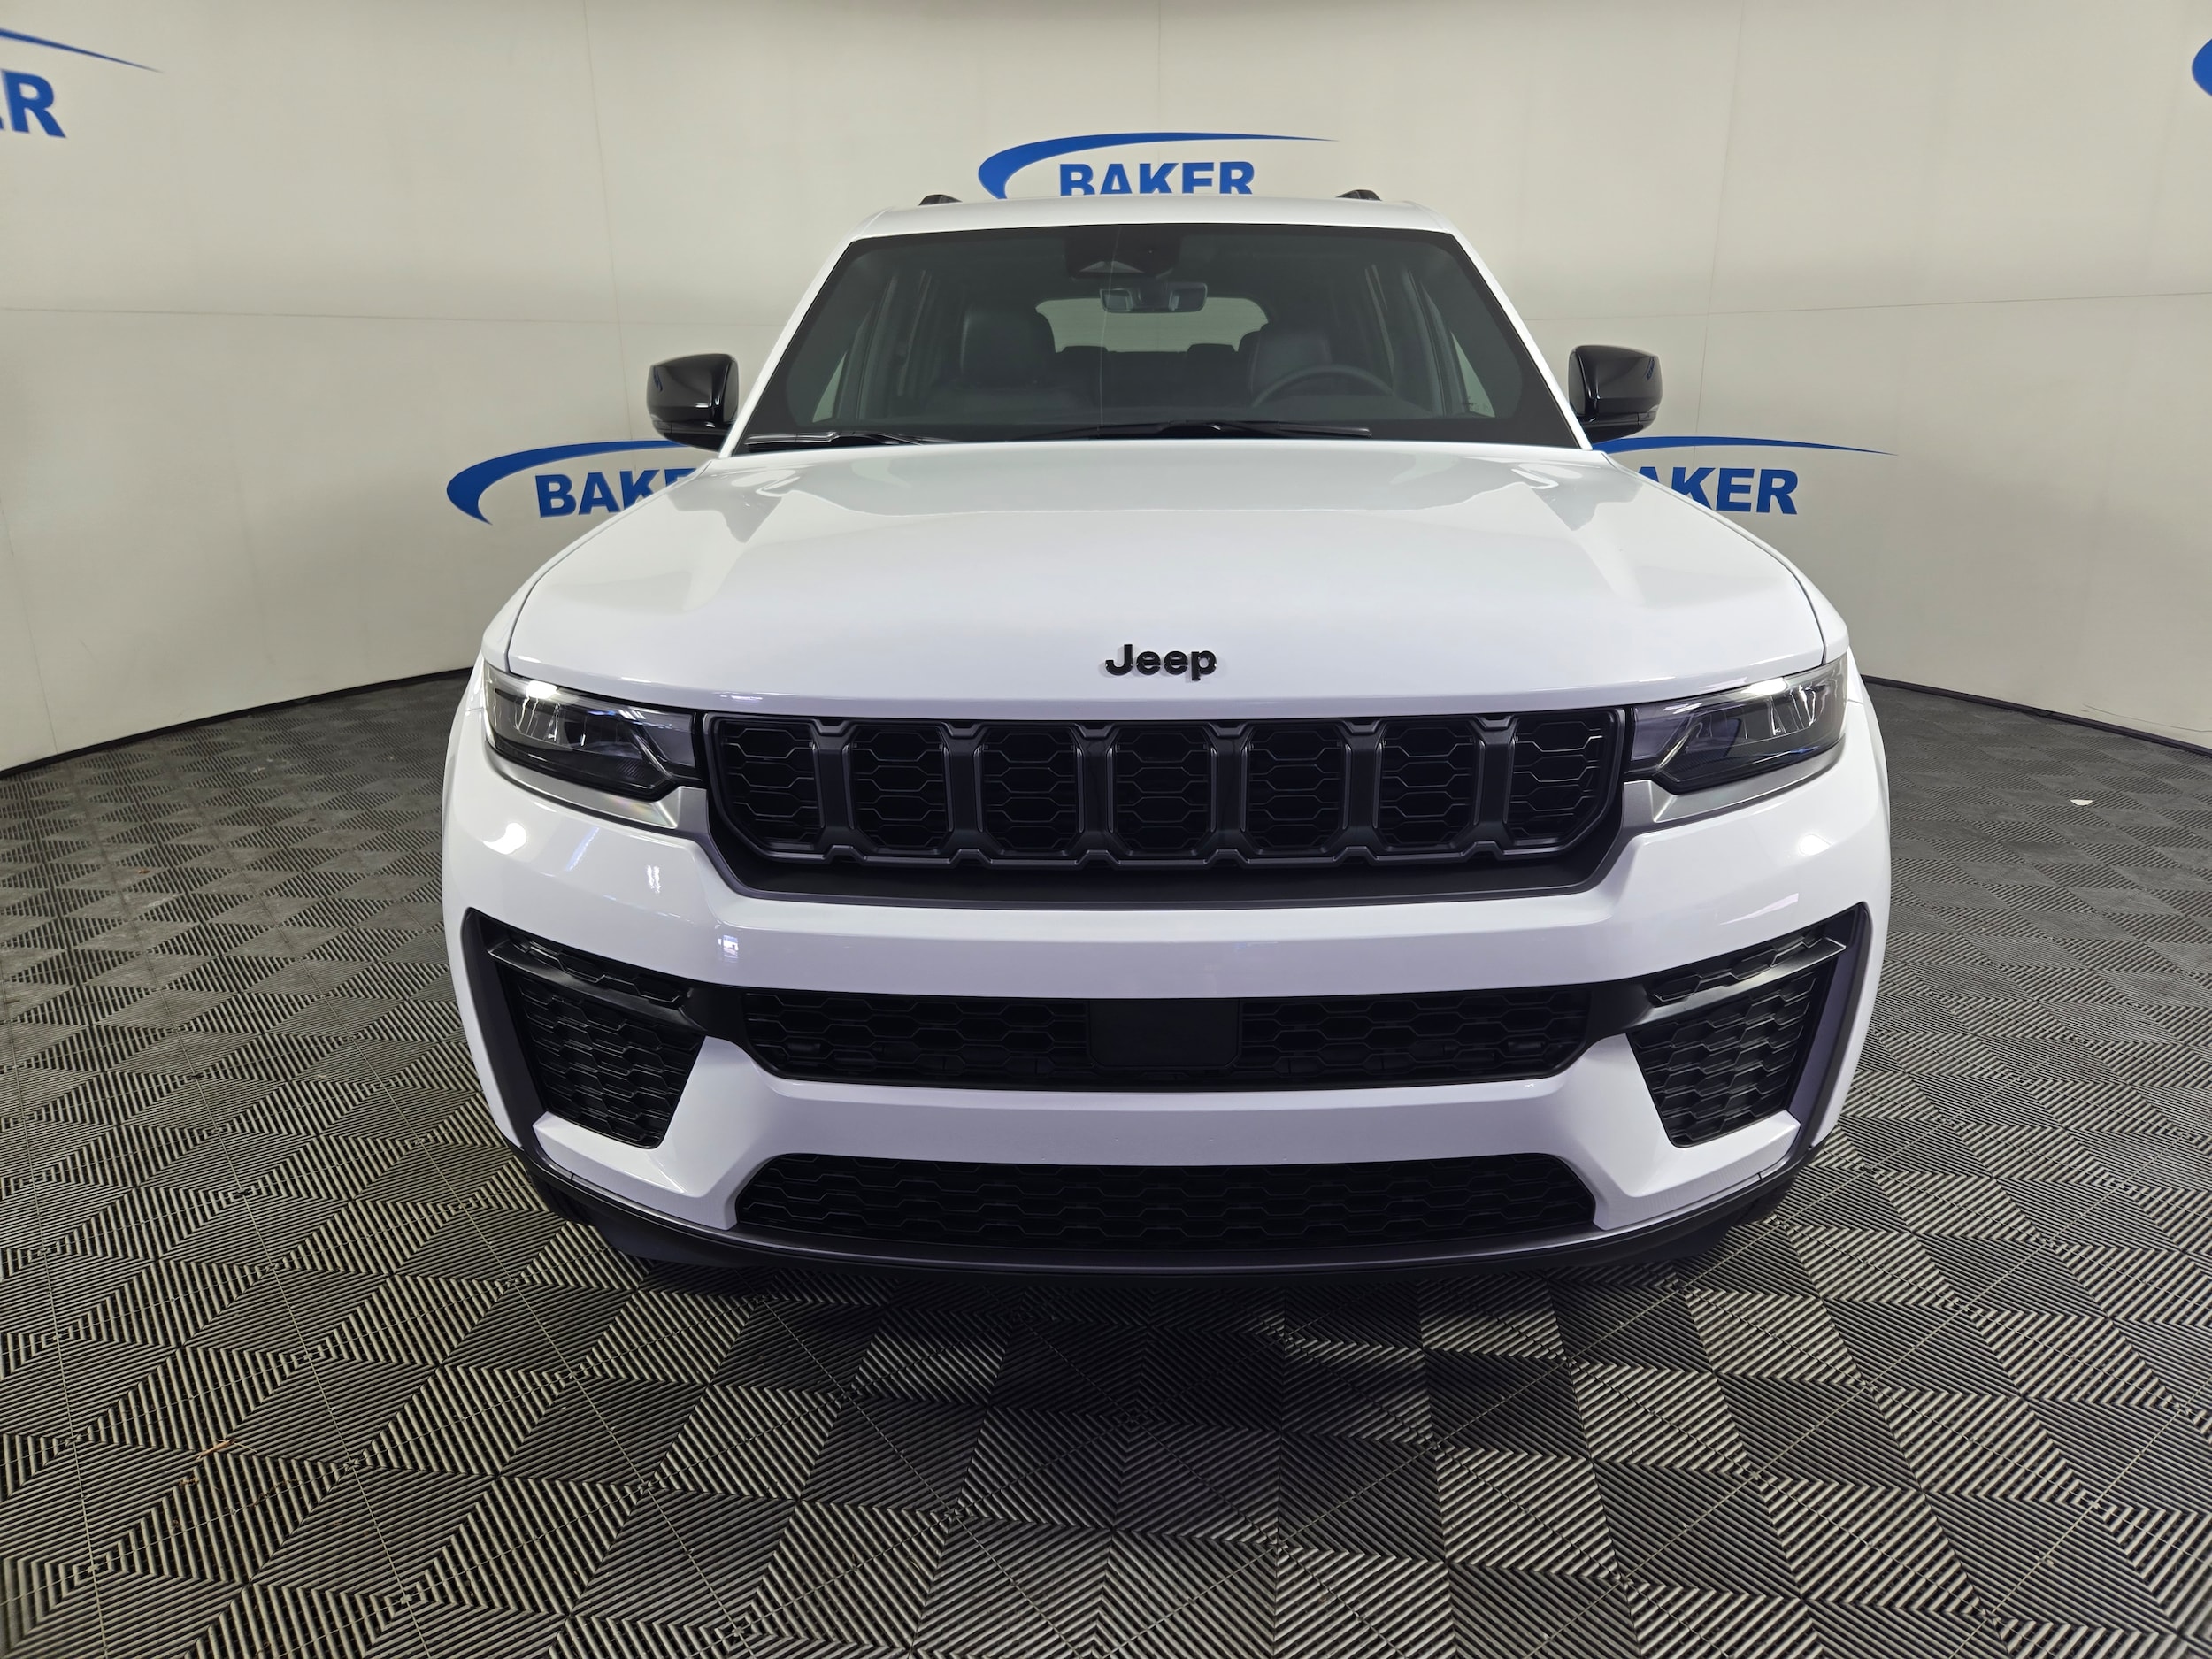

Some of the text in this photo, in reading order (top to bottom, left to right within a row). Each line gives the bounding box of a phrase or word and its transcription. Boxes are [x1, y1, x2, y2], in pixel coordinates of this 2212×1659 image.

[0, 68, 65, 138] R
[1059, 161, 1255, 196] BAKER
[1105, 644, 1217, 681] Jeep
